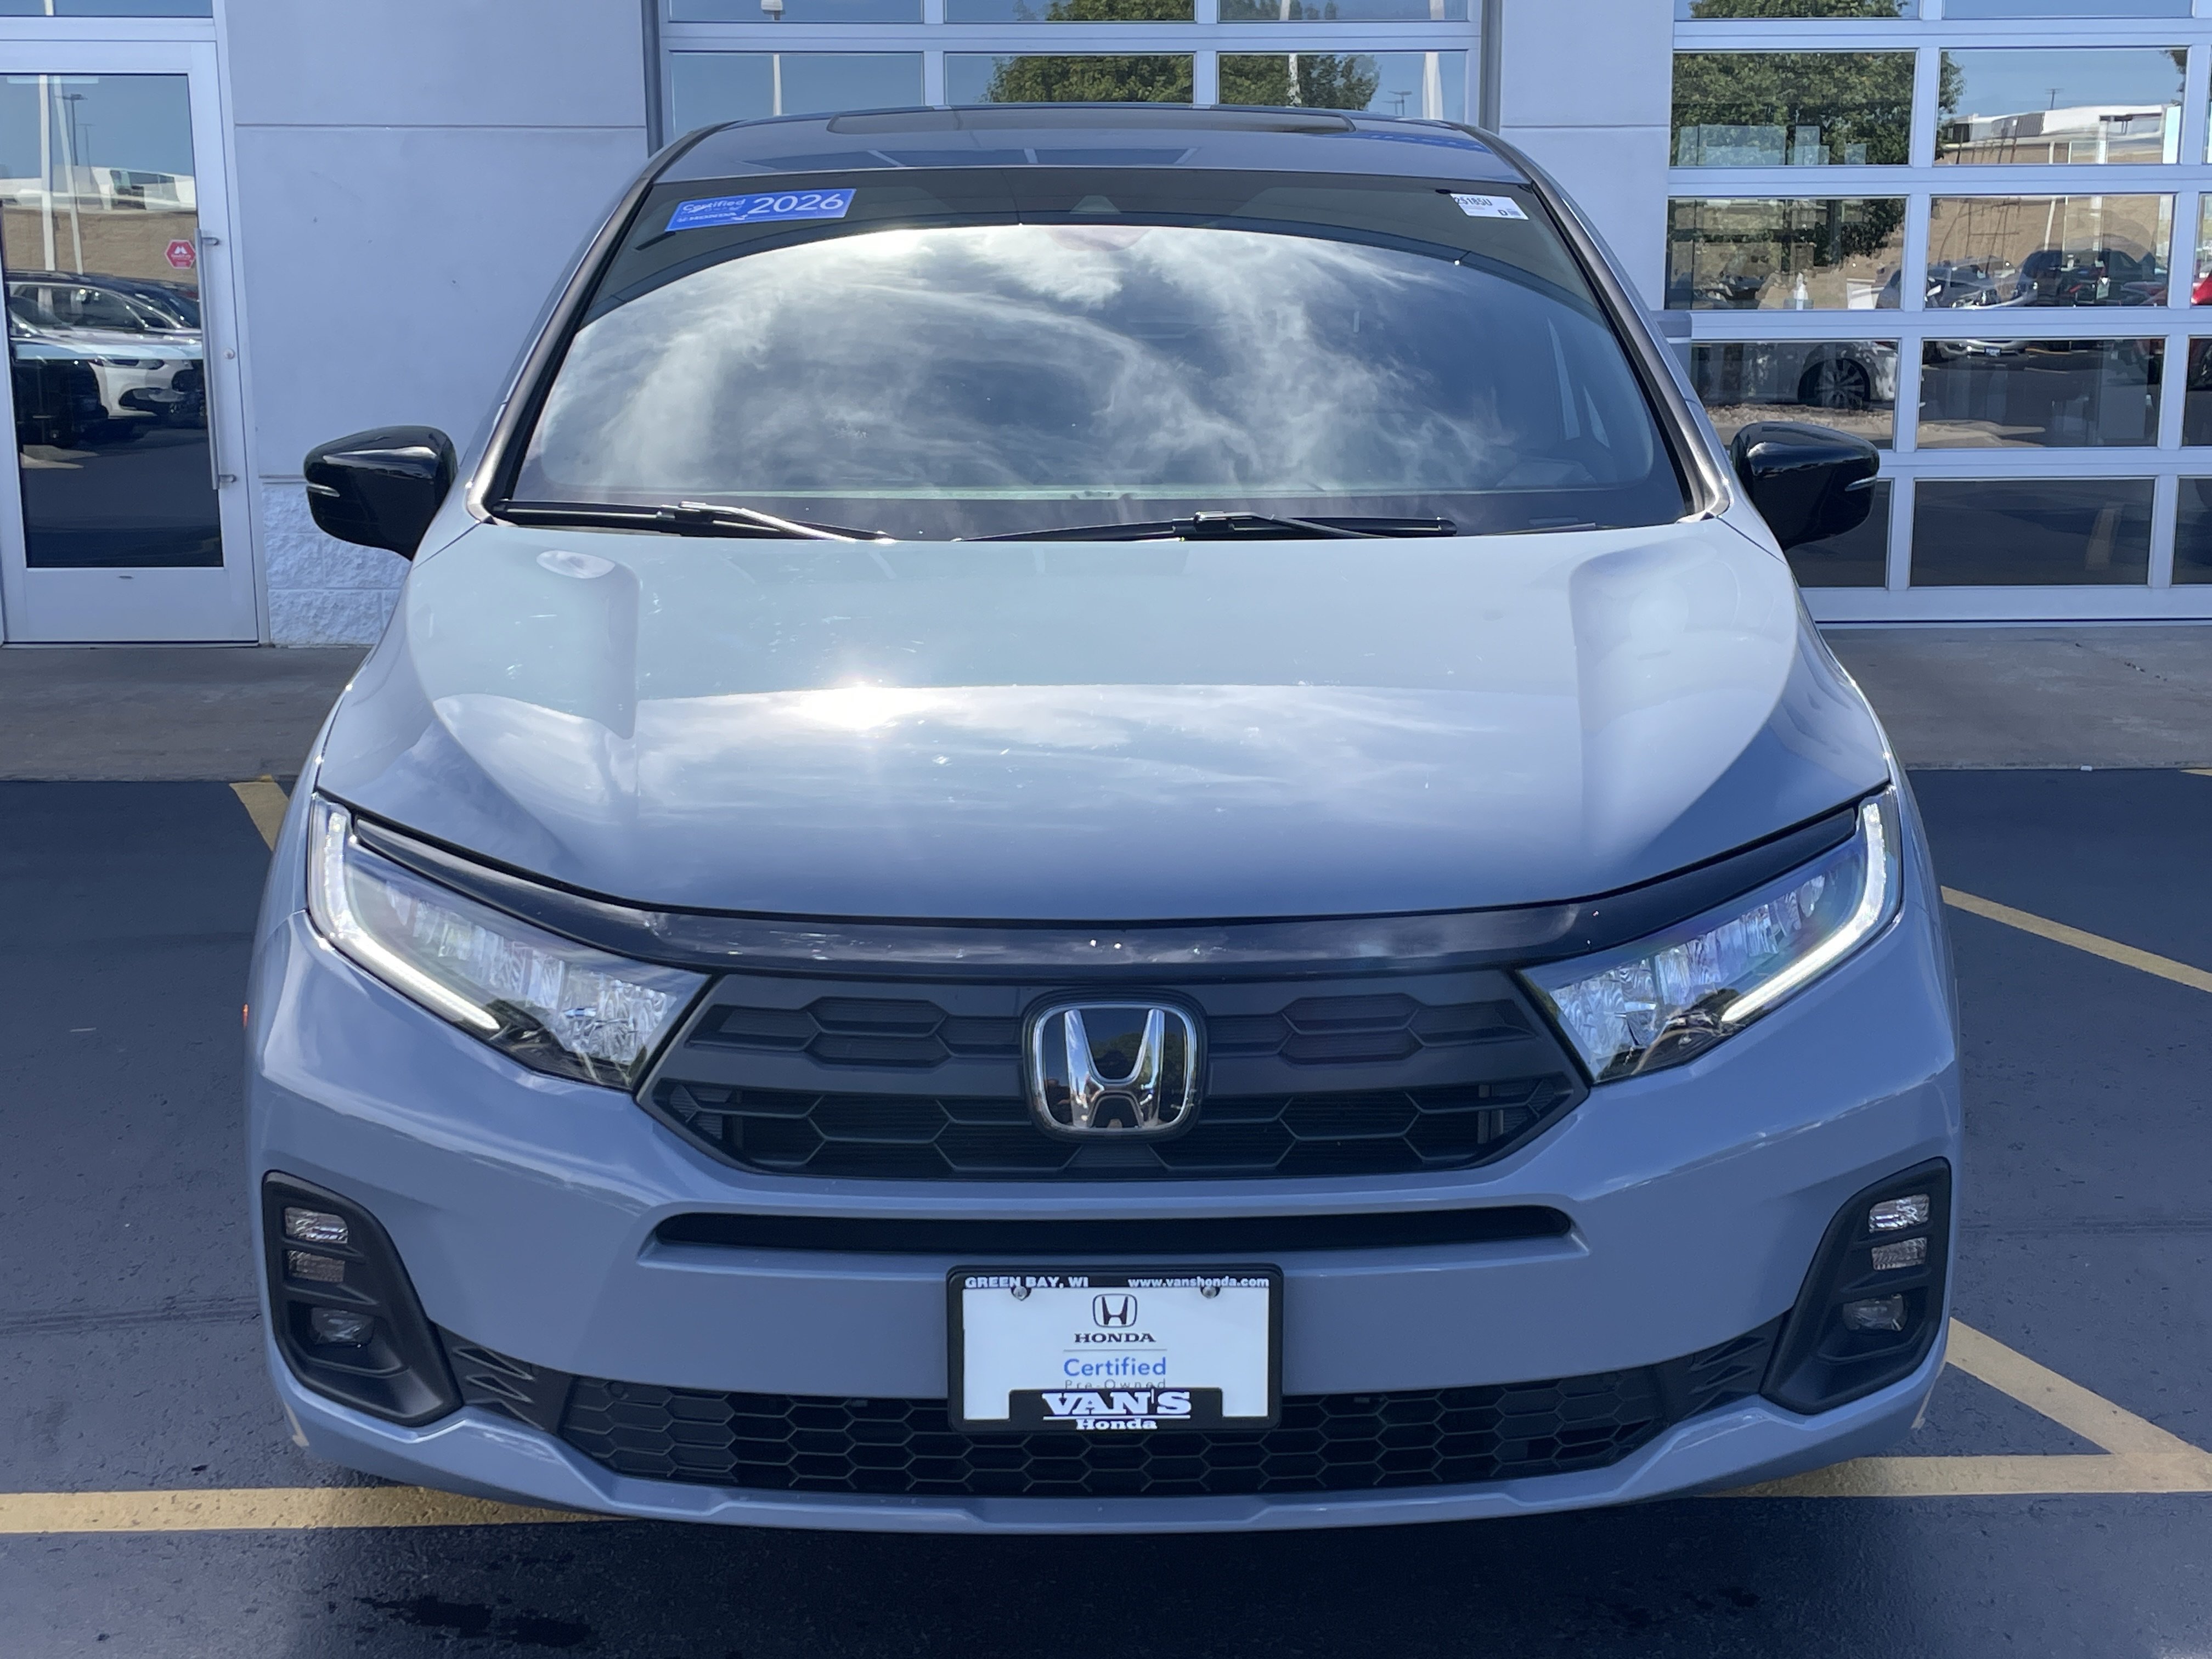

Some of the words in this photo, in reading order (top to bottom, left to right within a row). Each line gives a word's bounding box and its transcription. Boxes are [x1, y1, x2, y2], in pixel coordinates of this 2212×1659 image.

[747, 193, 844, 215] 2026
[964, 1276, 1021, 1288] GREEN
[1025, 1276, 1064, 1289] BAY,
[1068, 1276, 1089, 1288] WI
[1128, 1276, 1269, 1288] www.vanshonda.com
[1074, 1333, 1156, 1343] HONDA
[1063, 1356, 1166, 1376] Certified
[1064, 1378, 1166, 1389] Pre-Owned
[1042, 1389, 1192, 1416] VAN'S
[1076, 1418, 1158, 1430] Honda
